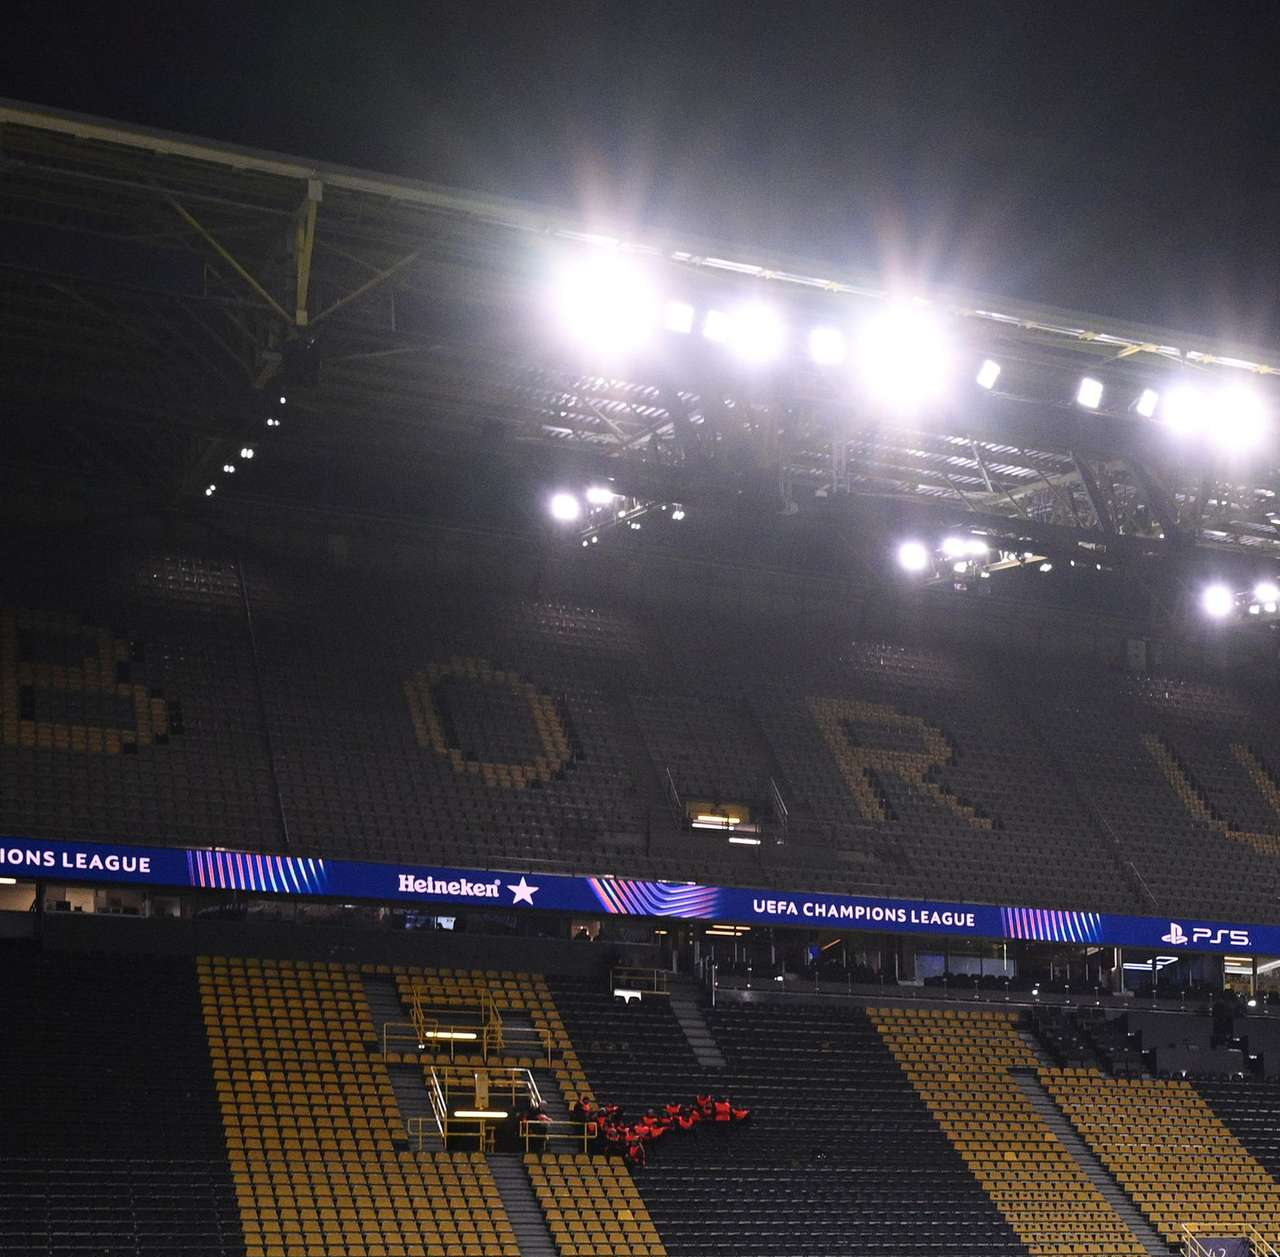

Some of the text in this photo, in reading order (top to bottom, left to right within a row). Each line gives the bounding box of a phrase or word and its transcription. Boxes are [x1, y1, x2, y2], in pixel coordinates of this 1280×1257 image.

[62, 852, 151, 873] LEAGUE
[398, 874, 500, 898] Heineken
[753, 898, 975, 927] UEFA CHAMPIONS LEAGUE
[1192, 927, 1250, 946] PS5
